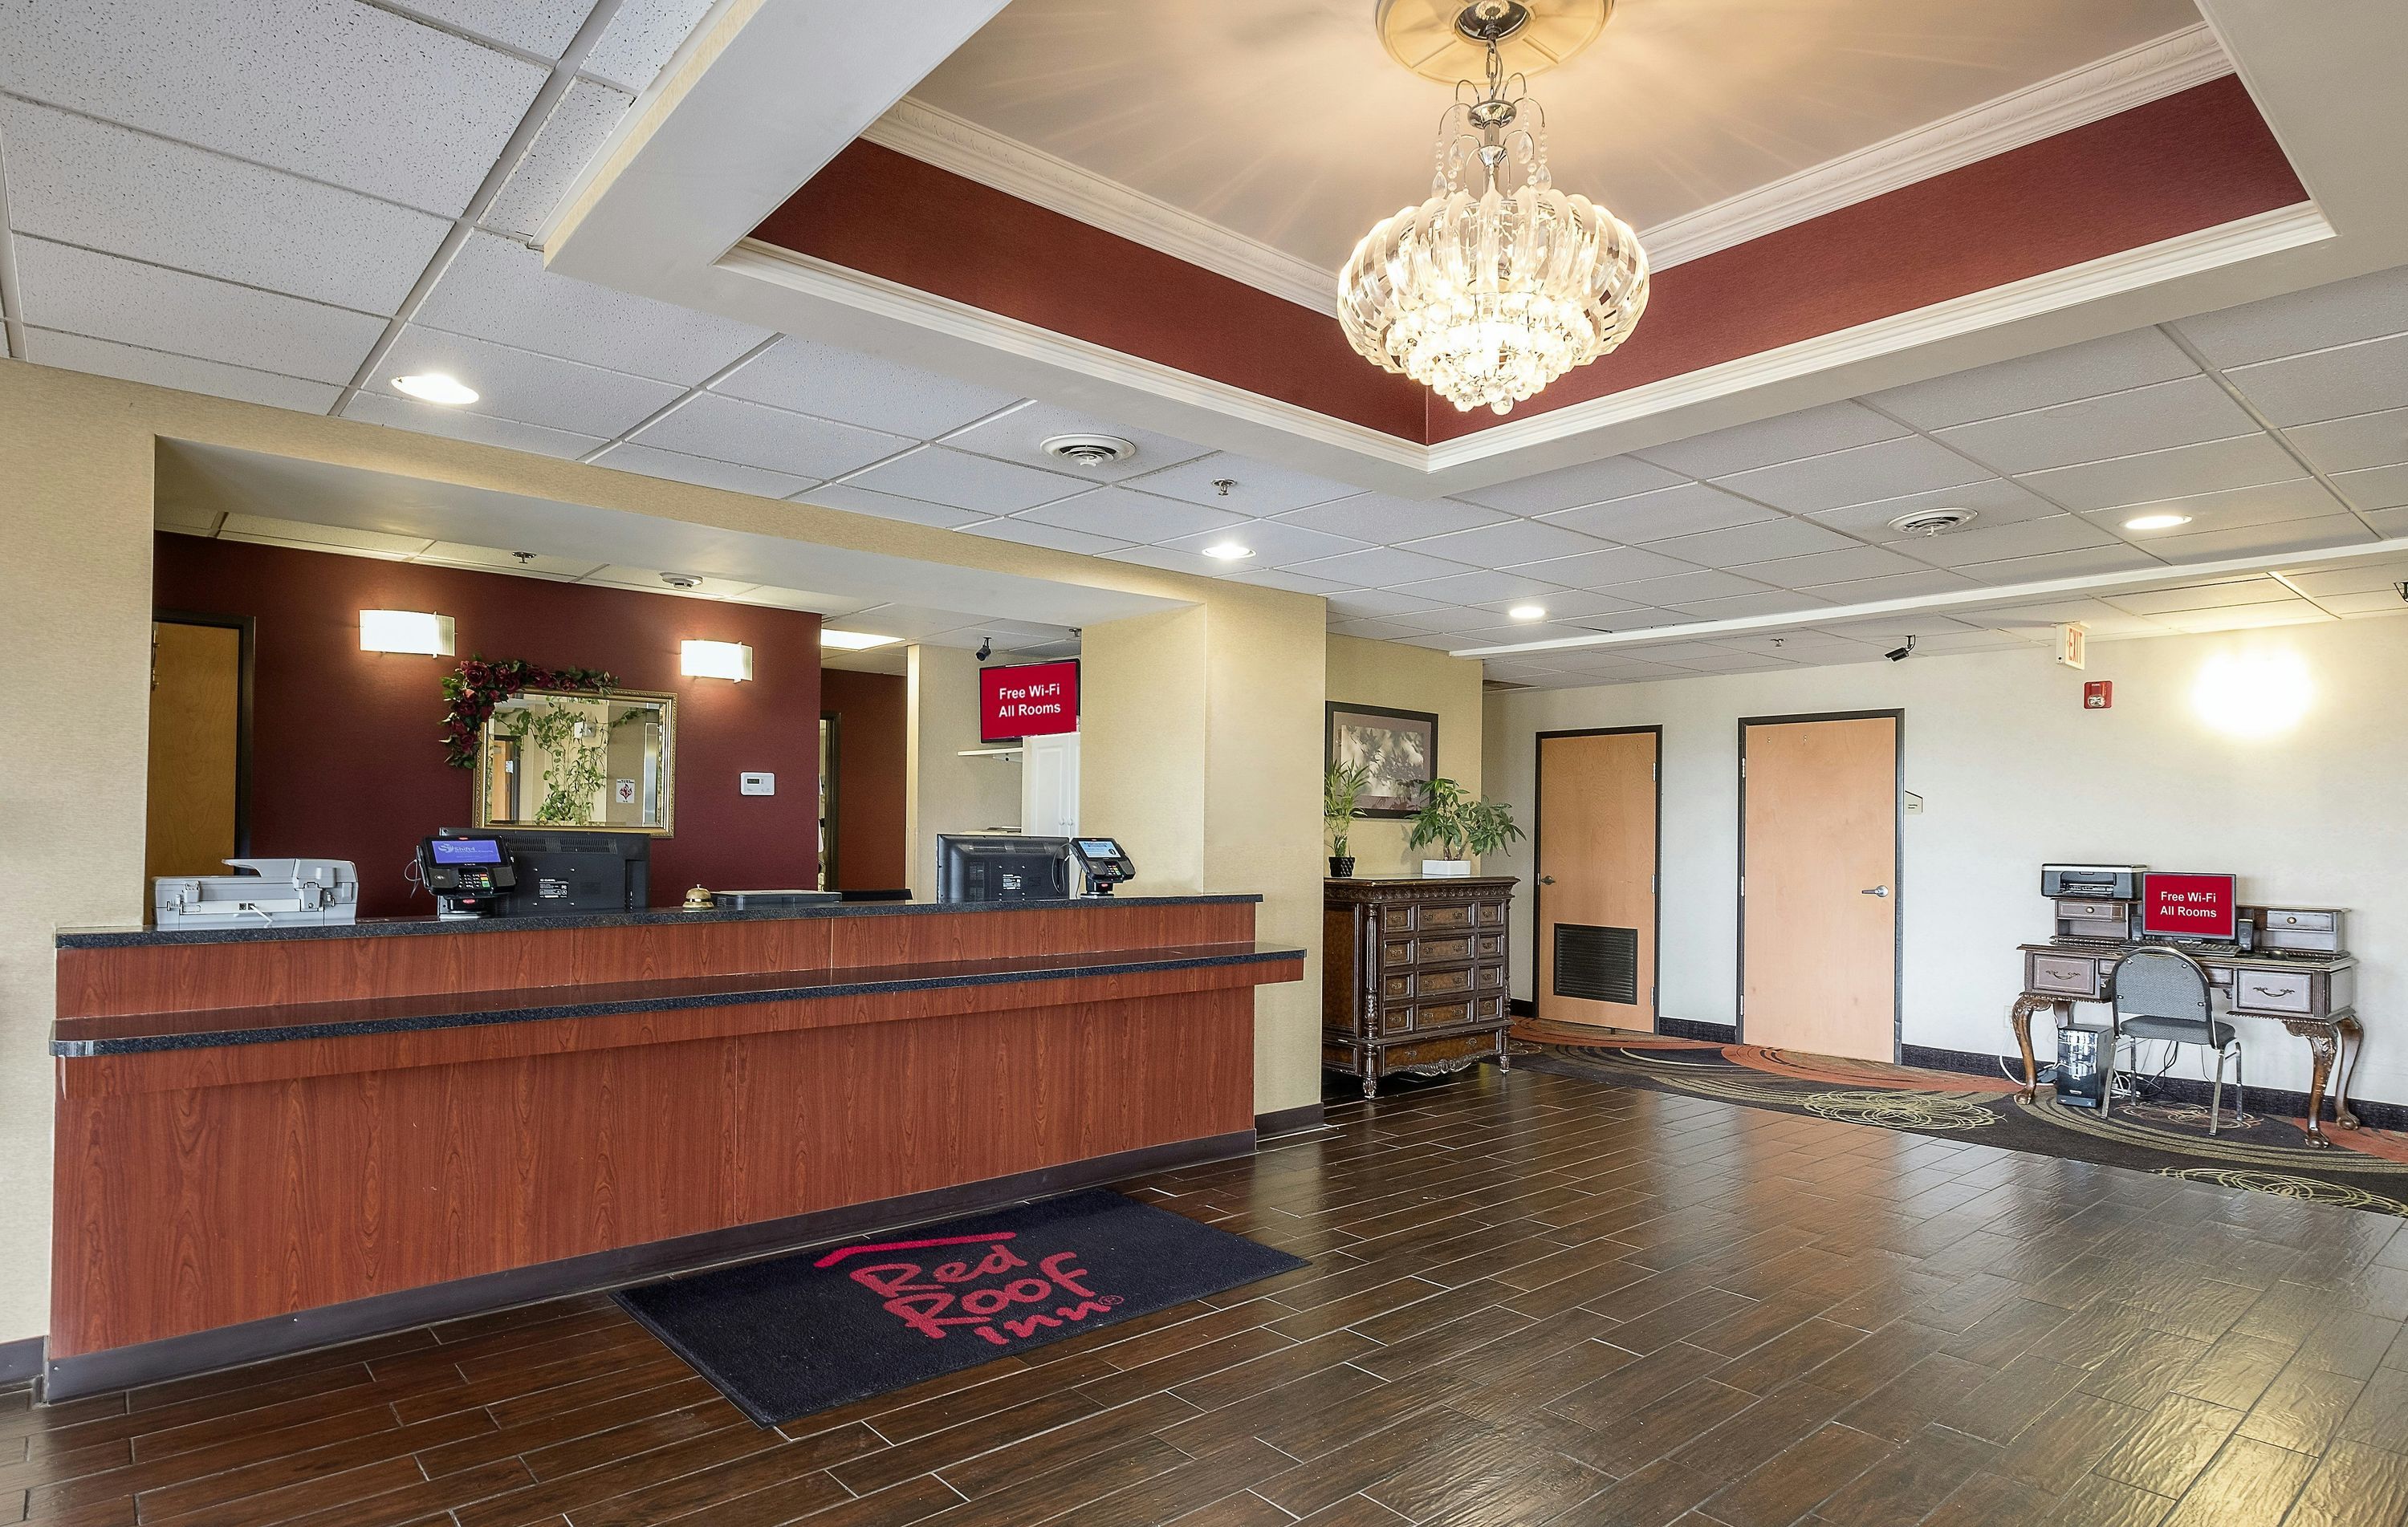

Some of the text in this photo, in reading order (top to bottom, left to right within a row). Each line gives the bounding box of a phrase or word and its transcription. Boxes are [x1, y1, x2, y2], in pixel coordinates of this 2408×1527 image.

[2068, 628, 2082, 664] EXIT
[999, 683, 1060, 700] Free Wi-Fi
[999, 703, 1061, 717] All Rooms
[2161, 891, 2216, 903] Free Wi-Fi
[2160, 905, 2217, 918] All Rooms
[849, 1244, 1029, 1298] Red
[884, 1250, 1096, 1340] Roof
